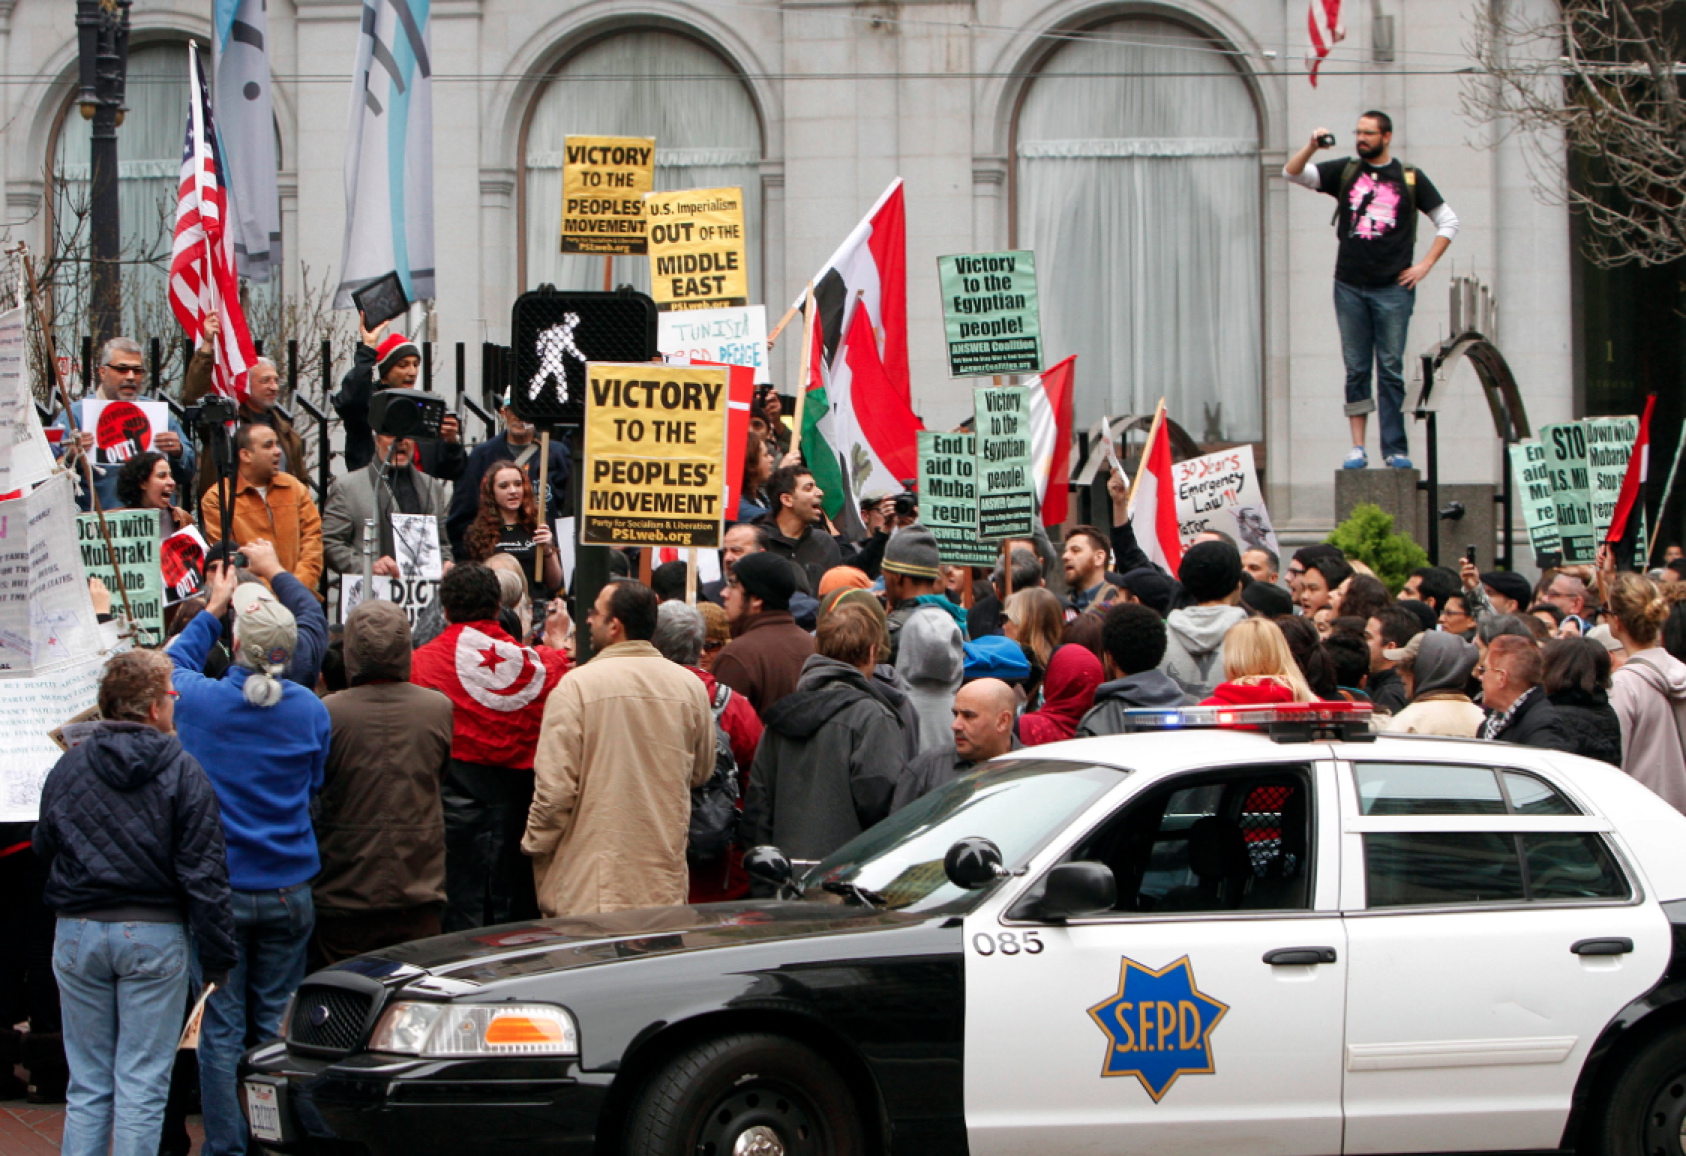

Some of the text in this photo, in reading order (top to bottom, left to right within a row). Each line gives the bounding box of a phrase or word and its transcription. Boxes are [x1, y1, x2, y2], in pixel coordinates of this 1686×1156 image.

[566, 145, 651, 166] VICTORY
[581, 170, 634, 188] TO THE
[567, 199, 646, 216] PEOPLES'
[650, 199, 738, 216] U.S. Imperialism
[564, 219, 647, 233] MOVEMENT
[651, 223, 692, 244] OUT
[700, 226, 715, 241] OF
[716, 224, 740, 240] THE
[656, 251, 739, 276] MIDDLE
[954, 256, 1016, 274] Victory
[672, 275, 727, 299] EAST
[963, 273, 1012, 293] to the
[953, 293, 1026, 314] Egyptian
[671, 312, 749, 341] TUNISIA
[959, 315, 1024, 338] people!
[952, 341, 991, 354] ANSWER
[590, 379, 724, 411] VICTORY
[984, 390, 1021, 412] Victory
[613, 419, 697, 444] TO THE
[991, 416, 1018, 435] to the
[1587, 421, 1635, 443] Down with
[106, 438, 139, 463] OUT!
[934, 435, 976, 455] End U
[984, 438, 1026, 461] Egyptian
[1551, 425, 1586, 460] STO
[1526, 445, 1544, 462] En
[593, 459, 715, 487] PEOPLES'
[926, 459, 973, 477] aid to
[1181, 454, 1240, 481] 30 Years
[1523, 463, 1547, 481] aid
[928, 479, 975, 499] Muba
[987, 468, 1025, 492] people!
[1179, 472, 1245, 499] Emergency
[1597, 471, 1618, 491] Stop
[1529, 483, 1551, 500] Mu
[589, 490, 718, 515] MOVEMENT
[1536, 505, 1554, 521] re
[1593, 501, 1617, 520] repr
[591, 518, 713, 530] Party for Socialism & Liberation
[1556, 503, 1576, 525] Aid
[1577, 507, 1588, 524] to
[121, 515, 154, 538] with
[611, 528, 693, 545] PSLweb.org
[964, 528, 977, 541] Co
[1178, 518, 1209, 536] ator
[123, 570, 145, 590] the
[176, 567, 199, 599] OUT!
[389, 578, 441, 605] DICT
[972, 931, 1045, 956] 085
[1114, 1000, 1203, 1053] S.F.P.D.
